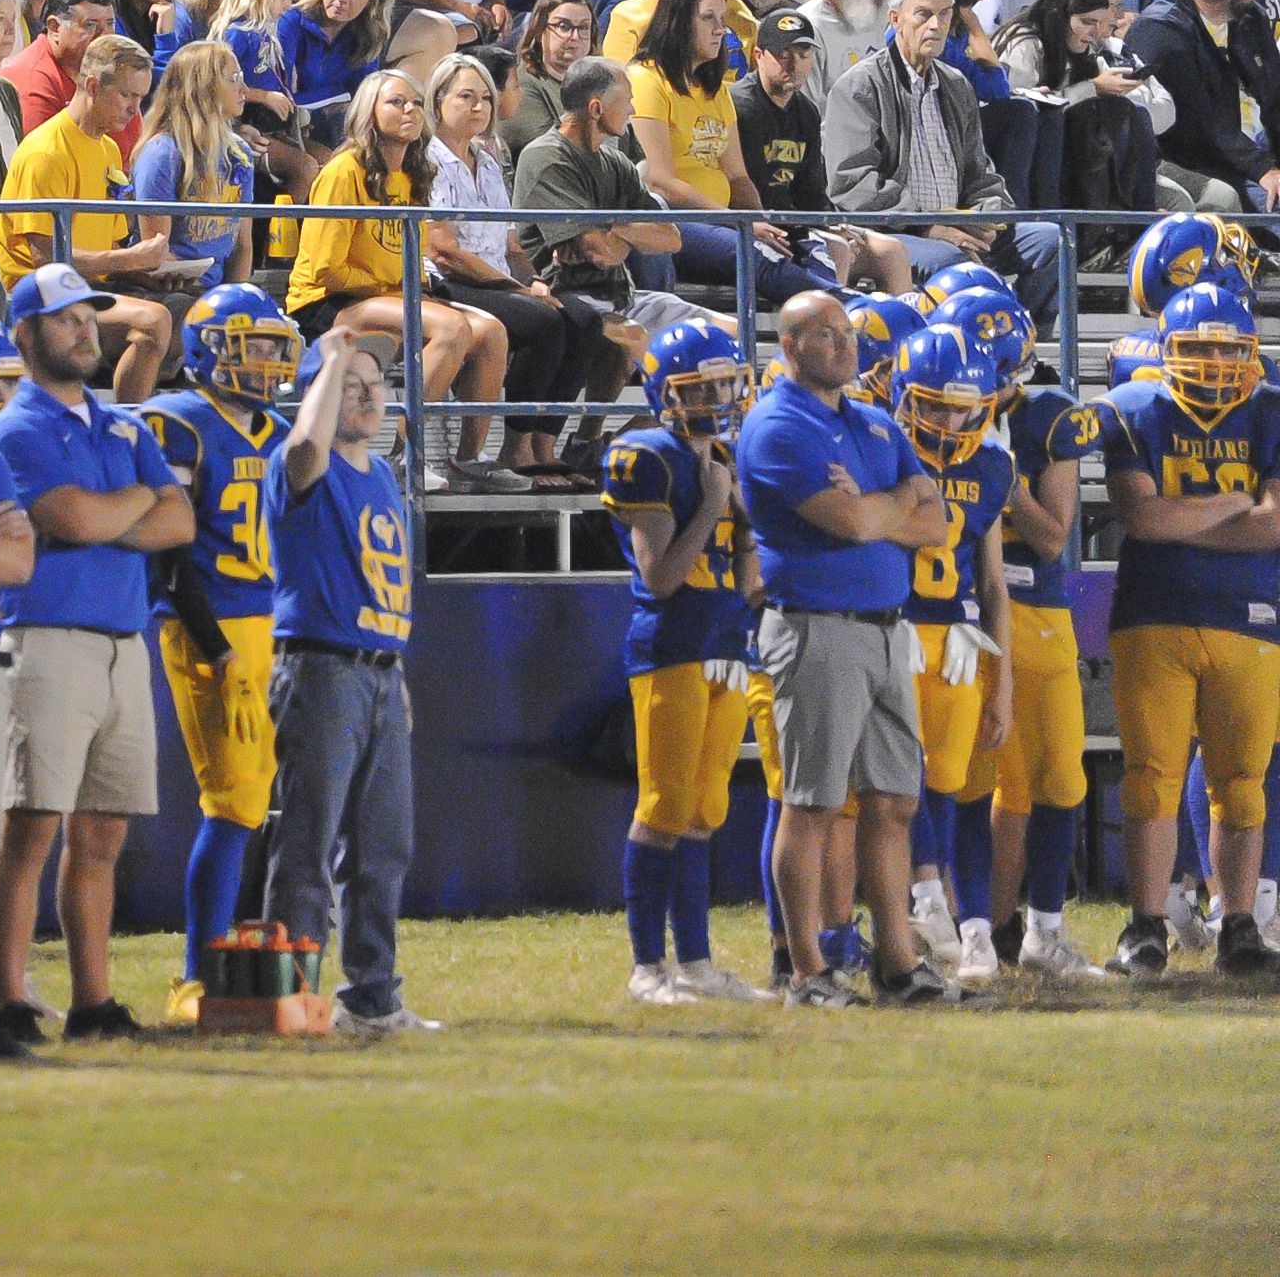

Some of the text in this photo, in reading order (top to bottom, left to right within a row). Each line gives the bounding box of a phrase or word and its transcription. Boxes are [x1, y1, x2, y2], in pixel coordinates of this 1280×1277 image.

[976, 310, 1013, 340] 33
[608, 448, 639, 483] 17
[215, 480, 278, 584] 3
